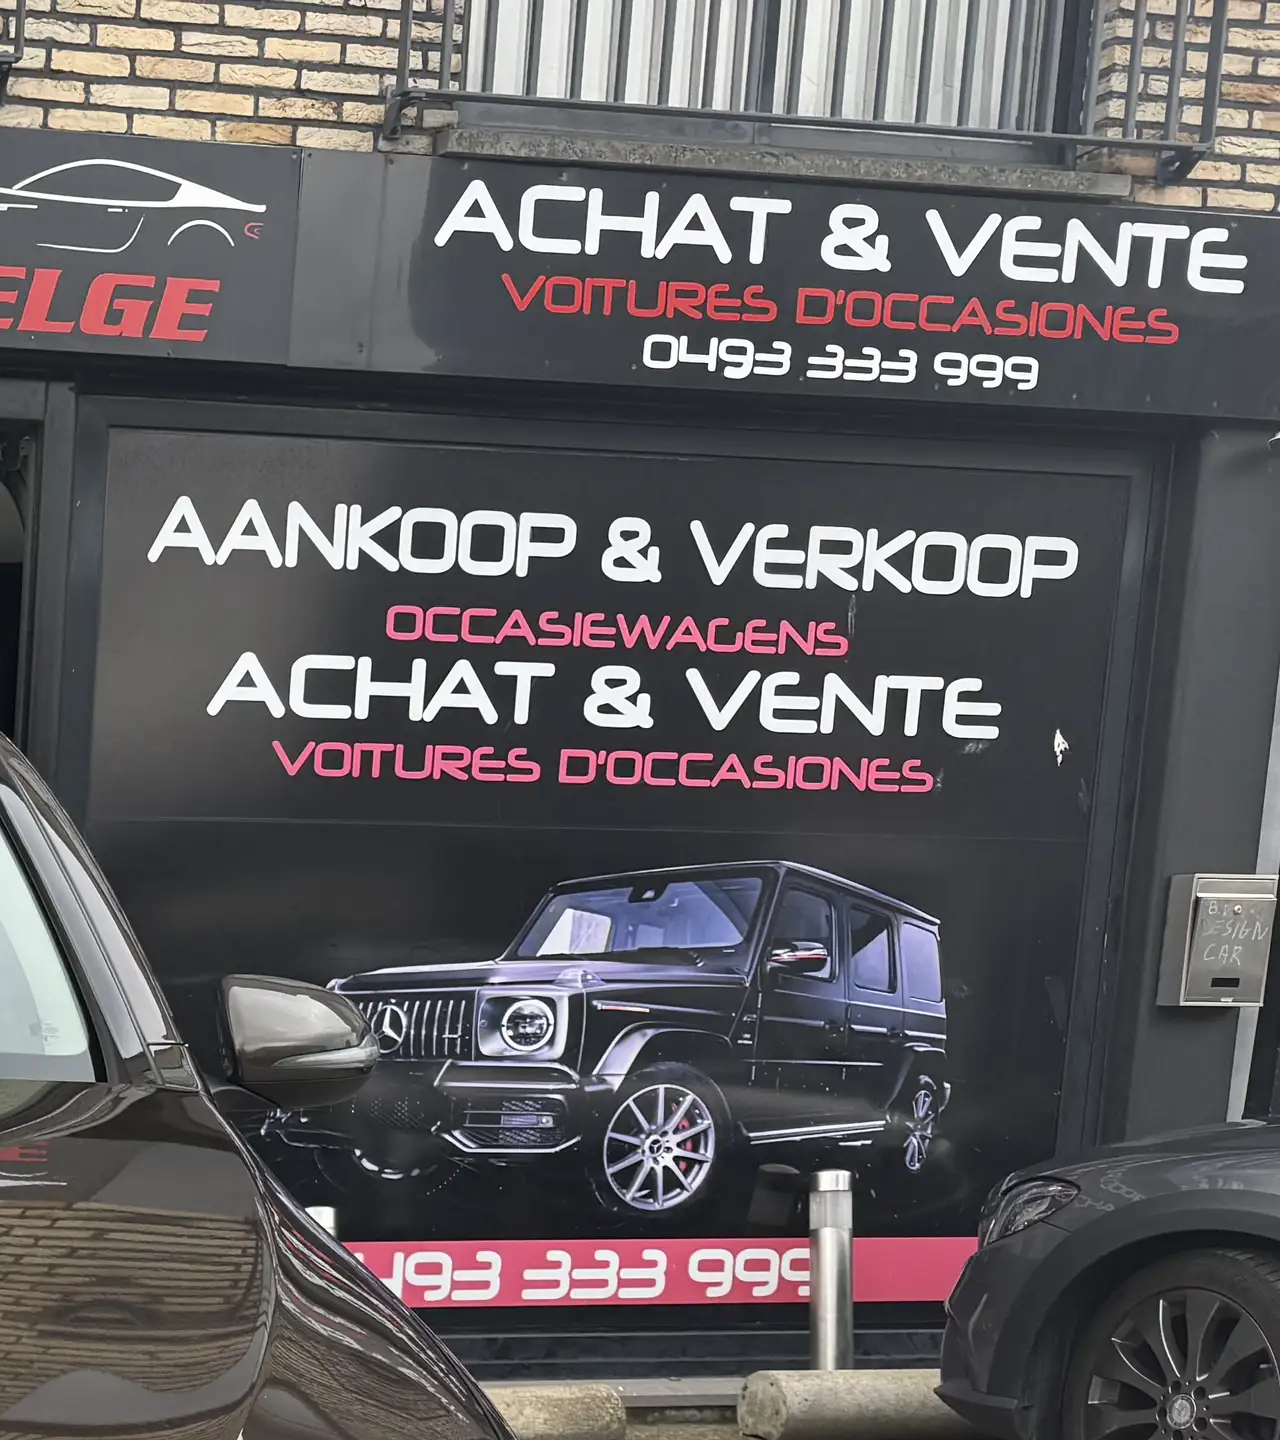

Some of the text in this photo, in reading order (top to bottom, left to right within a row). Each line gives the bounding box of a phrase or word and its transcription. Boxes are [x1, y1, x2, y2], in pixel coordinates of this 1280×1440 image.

[433, 179, 1248, 294] ACHAT & VENTE
[501, 273, 1180, 345] VOITURES D'OCCASIONES
[642, 333, 1039, 391] 0493 333 999
[147, 495, 1079, 599] AANKOOP & VERKOOP
[386, 605, 849, 657] OCCASIEWAGENS
[206, 651, 1002, 740] ACHAT & VENTE
[272, 741, 934, 793] VOITURES D'OCCASIONES
[1201, 918, 1269, 941] DESIGN
[1203, 943, 1243, 966] CAR
[354, 1250, 502, 1302] 493
[521, 1248, 668, 1300] 333
